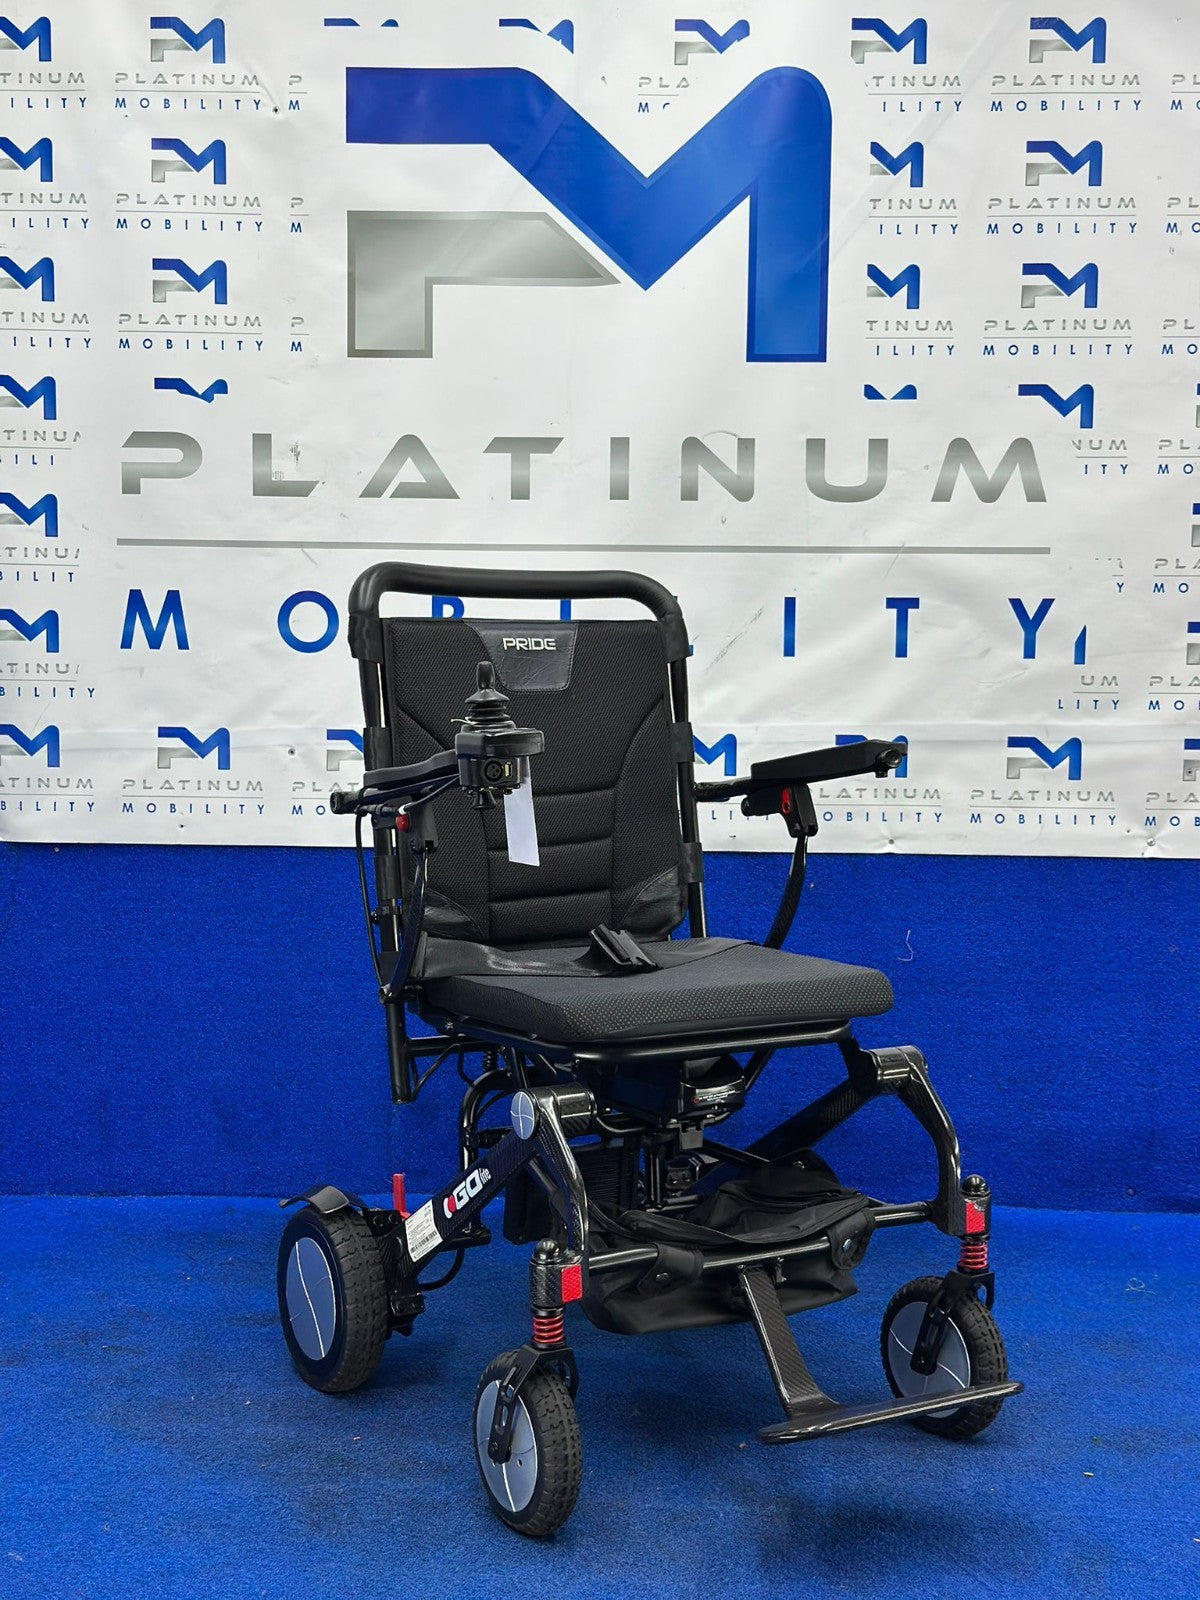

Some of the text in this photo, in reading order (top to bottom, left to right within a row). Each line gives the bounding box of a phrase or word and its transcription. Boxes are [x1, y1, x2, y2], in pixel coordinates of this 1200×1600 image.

[115, 72, 259, 86] PLATINUM
[992, 74, 1140, 86] PLATINUM
[115, 98, 261, 110] MOBILITY
[991, 100, 1141, 111] MOBILITY
[116, 193, 261, 207] PLATINUM
[988, 197, 1136, 209] PLATINUM
[116, 218, 262, 232] MOBILITY
[987, 223, 1137, 234] MOBILITY
[119, 313, 261, 327] PLATINUM
[984, 319, 1131, 331] PLATINUM
[119, 338, 263, 351] MOBILITY
[983, 344, 1132, 355] MOBILITY
[121, 431, 1047, 503] PLATINUM
[120, 589, 1055, 659] MOITY
[503, 638, 556, 650] PRIDE
[122, 779, 263, 791] PLATINUM
[820, 788, 941, 799] LATINUM
[971, 790, 1115, 802] PLATINUM
[122, 803, 264, 814] MOBILITY
[970, 813, 1116, 825] MOBILITY
